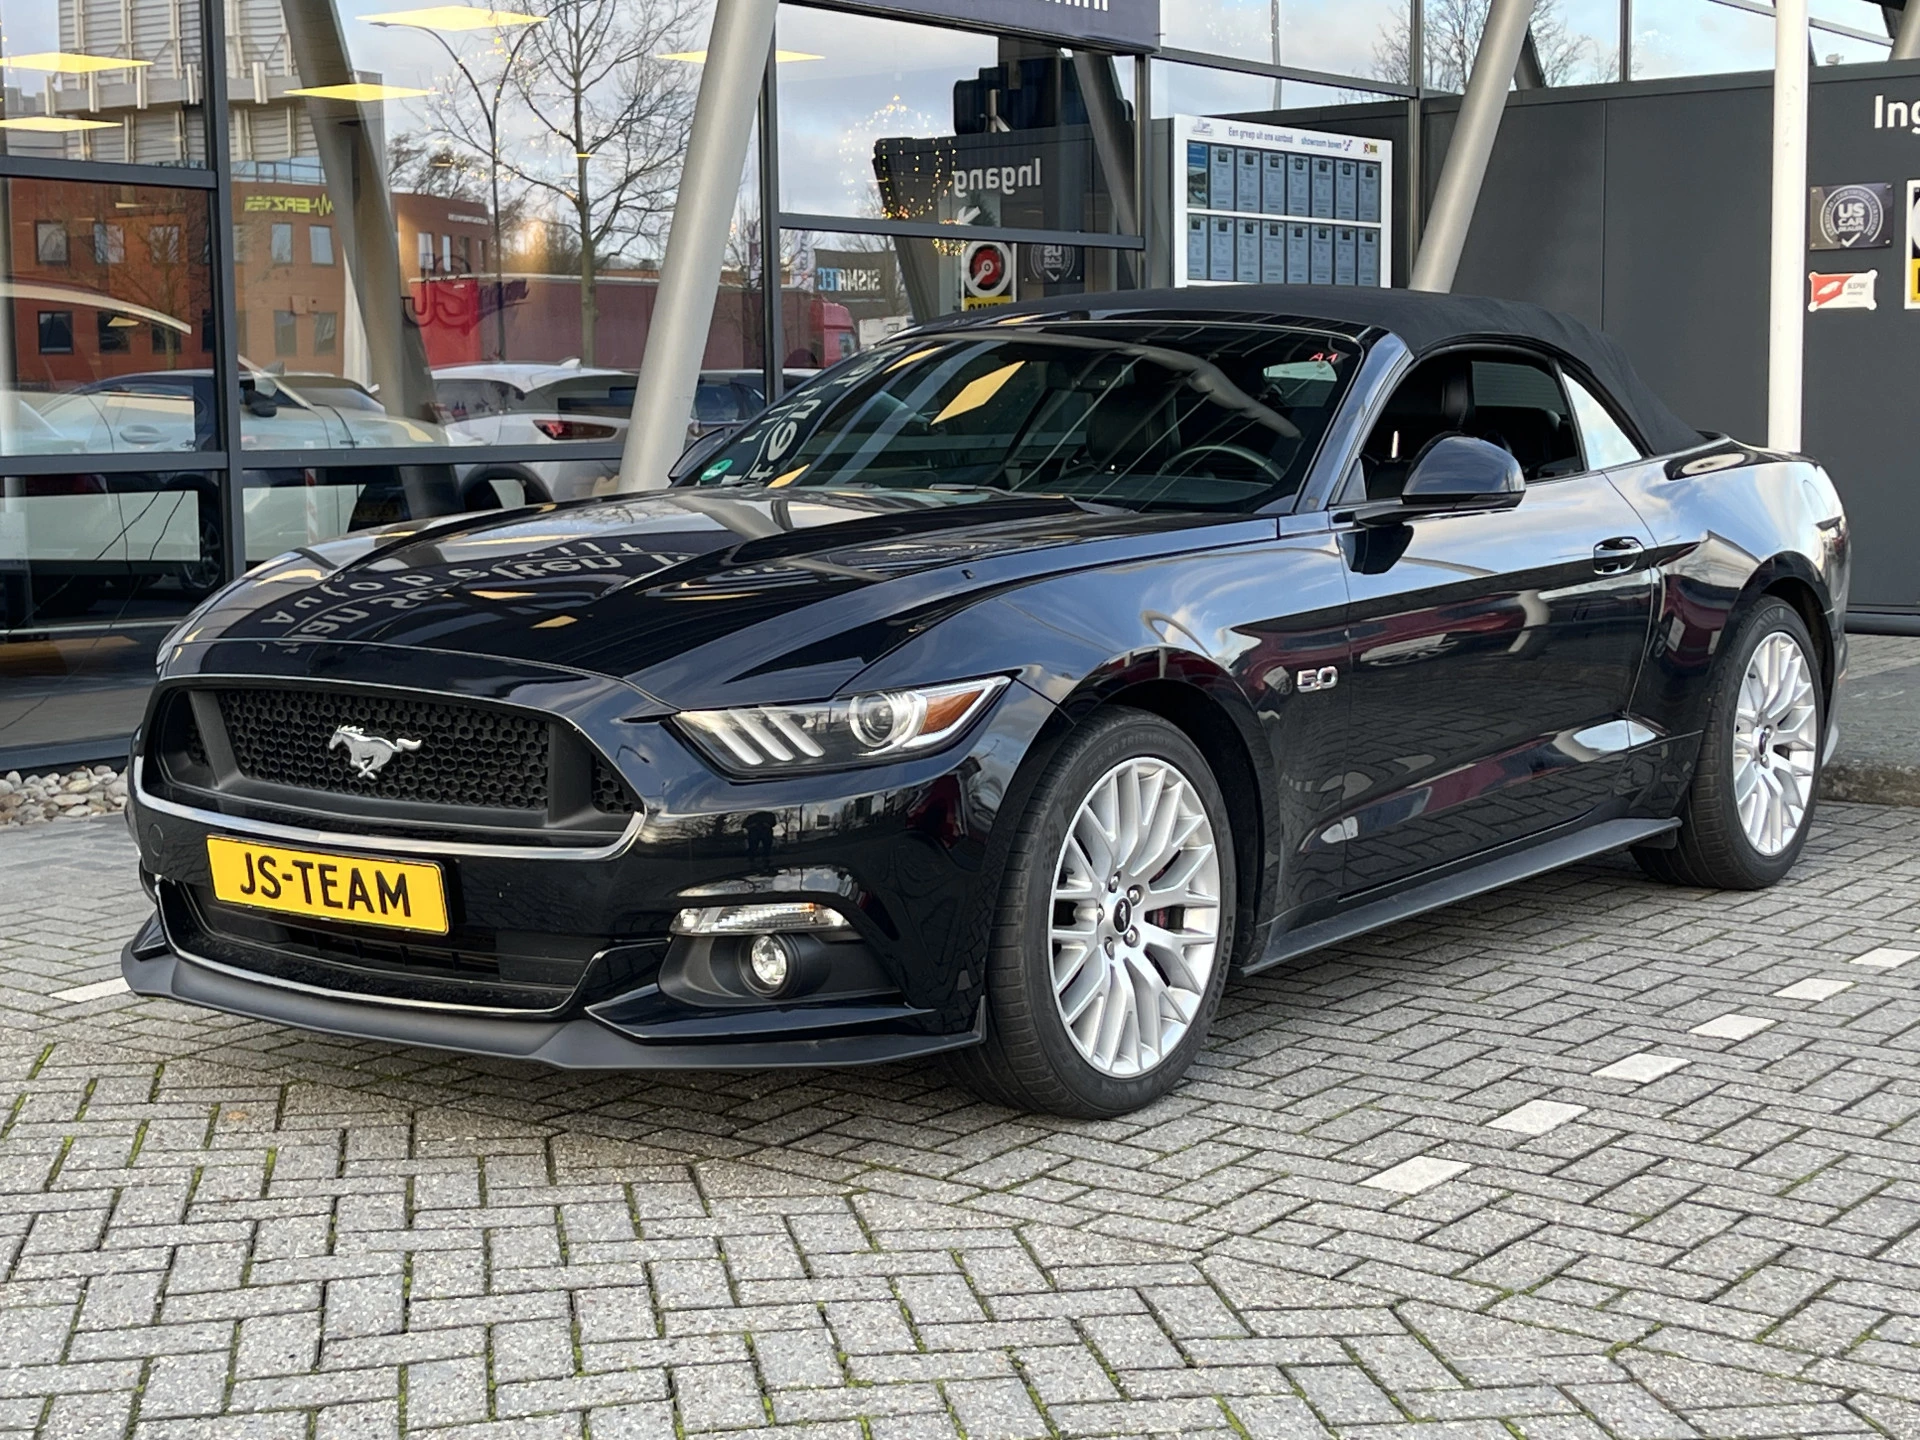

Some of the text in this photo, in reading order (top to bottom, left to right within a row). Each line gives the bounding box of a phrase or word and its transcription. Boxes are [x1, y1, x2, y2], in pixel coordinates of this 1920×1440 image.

[1838, 202, 1865, 218] US
[1838, 217, 1864, 226] CAR
[1297, 666, 1338, 693] 5.0
[240, 852, 411, 917] JS-TEAM
[1206, 915, 1234, 1018] KUMHO
